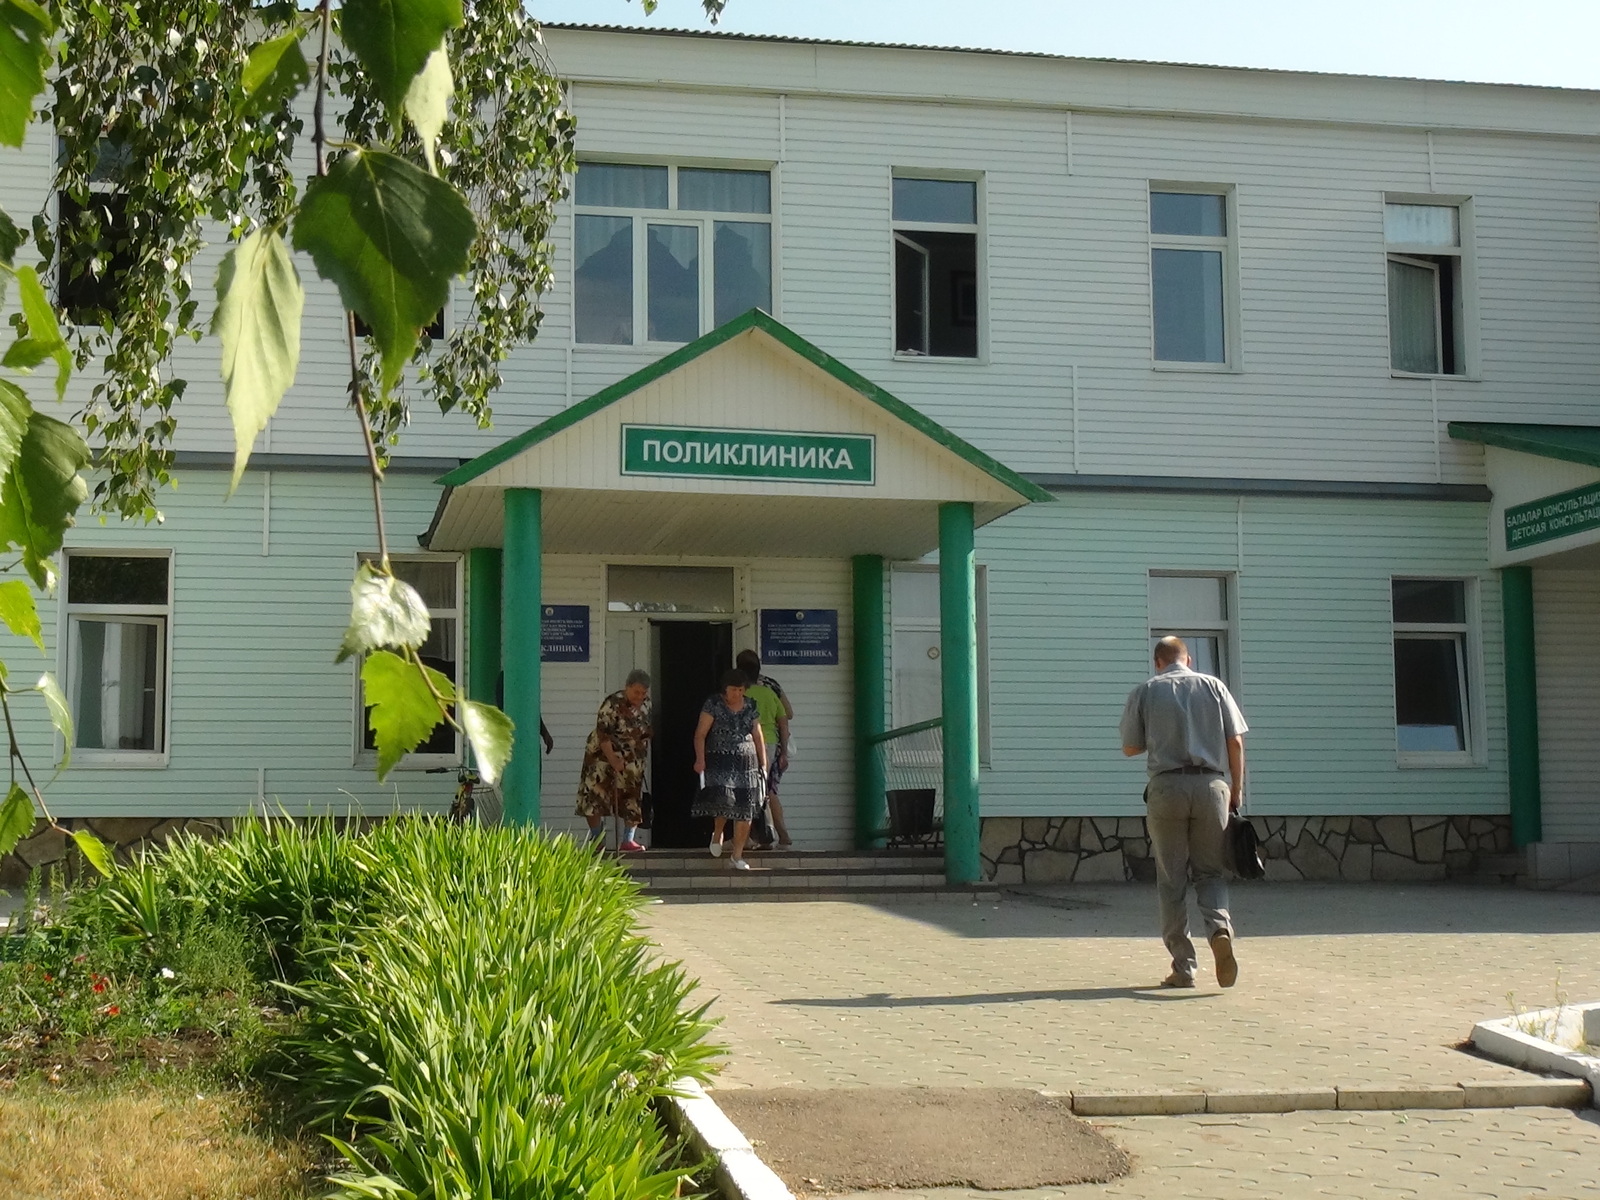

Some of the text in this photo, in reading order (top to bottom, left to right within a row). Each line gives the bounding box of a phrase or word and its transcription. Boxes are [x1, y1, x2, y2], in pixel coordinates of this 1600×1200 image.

[643, 439, 853, 470] ПОЛИКЛИНИКА
[1512, 521, 1547, 542] ДЕТСКАЯ
[540, 644, 584, 653] КЛИНИКА
[767, 649, 833, 658] ПОЛИКЛИНИКА
